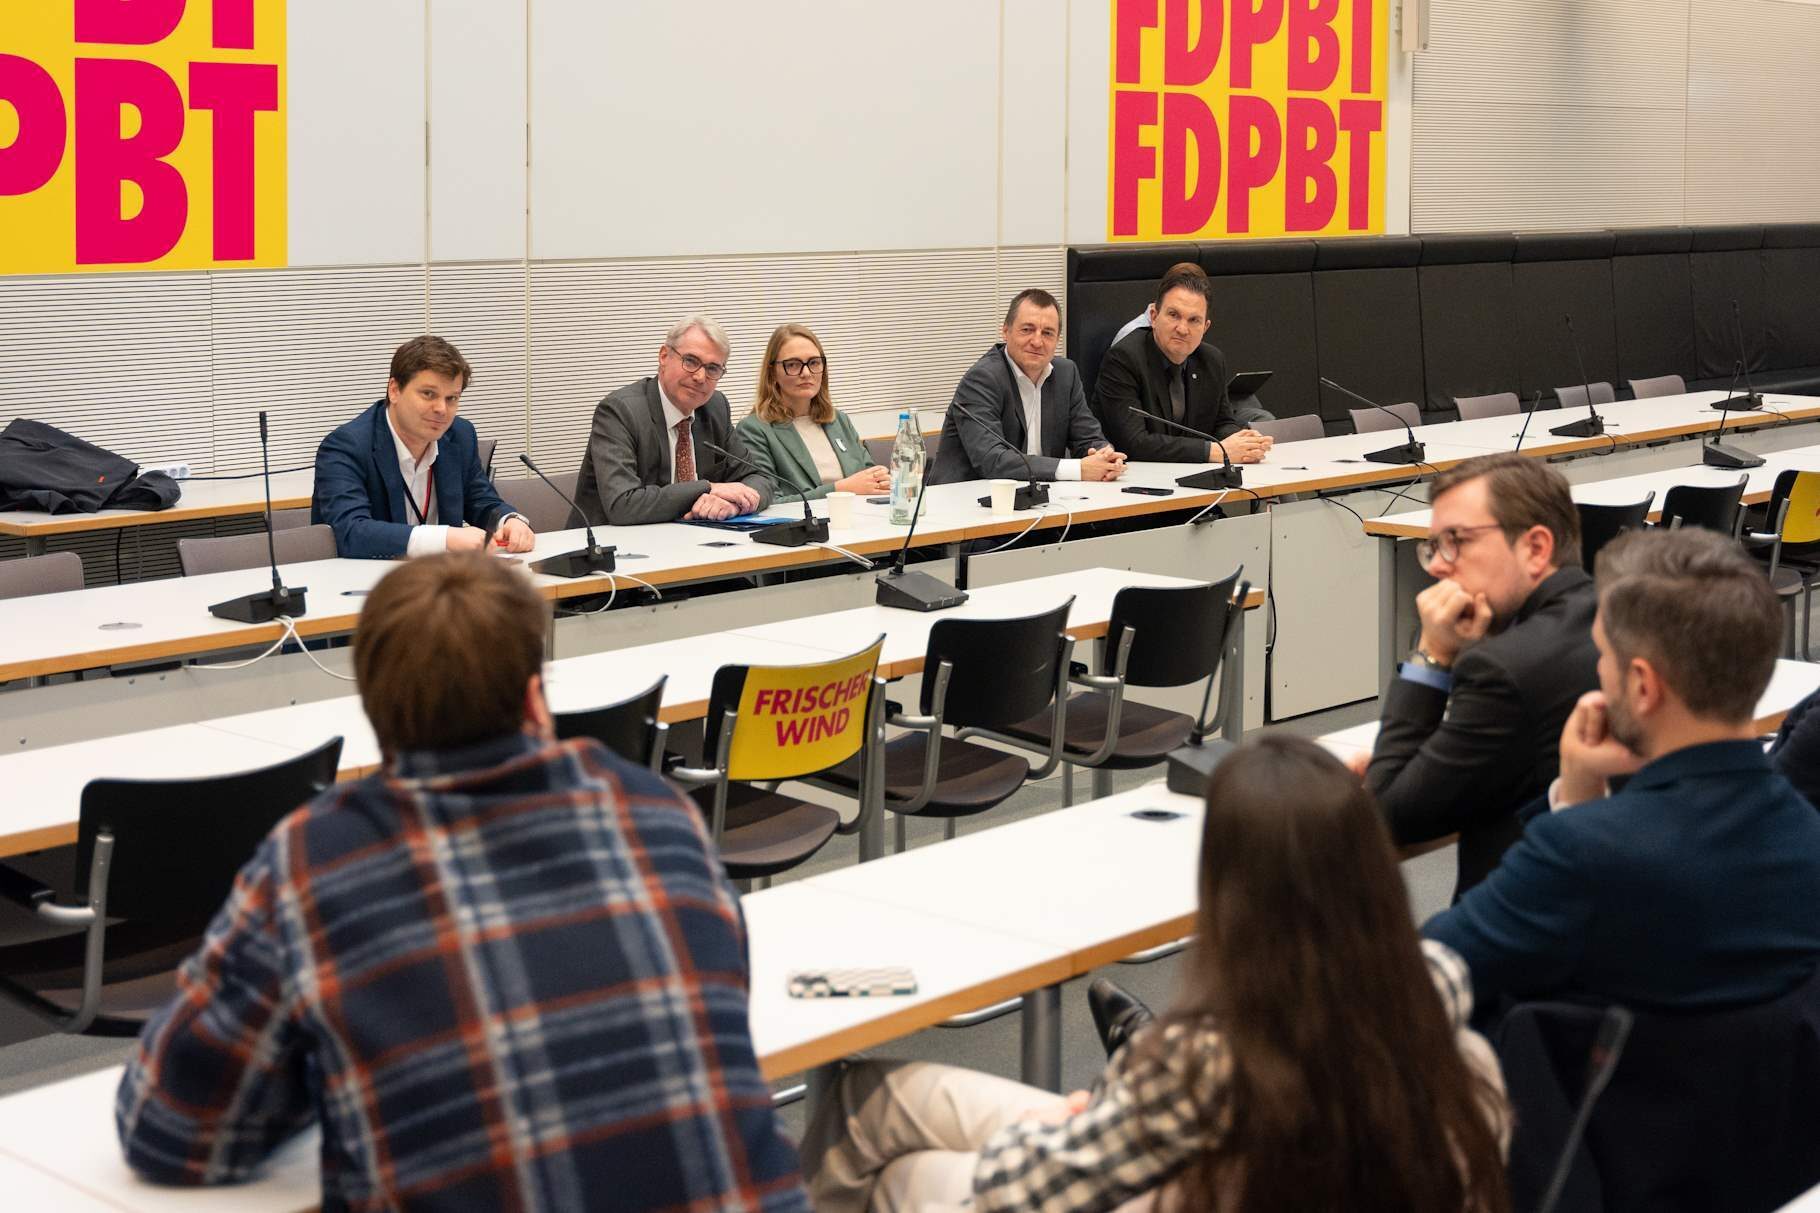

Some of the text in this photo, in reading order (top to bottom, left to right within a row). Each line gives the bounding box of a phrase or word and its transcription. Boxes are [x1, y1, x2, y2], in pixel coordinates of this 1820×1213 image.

[1113, 90, 1382, 236] FDPBT
[753, 668, 871, 715] FRISCHER
[776, 707, 850, 747] WIND
